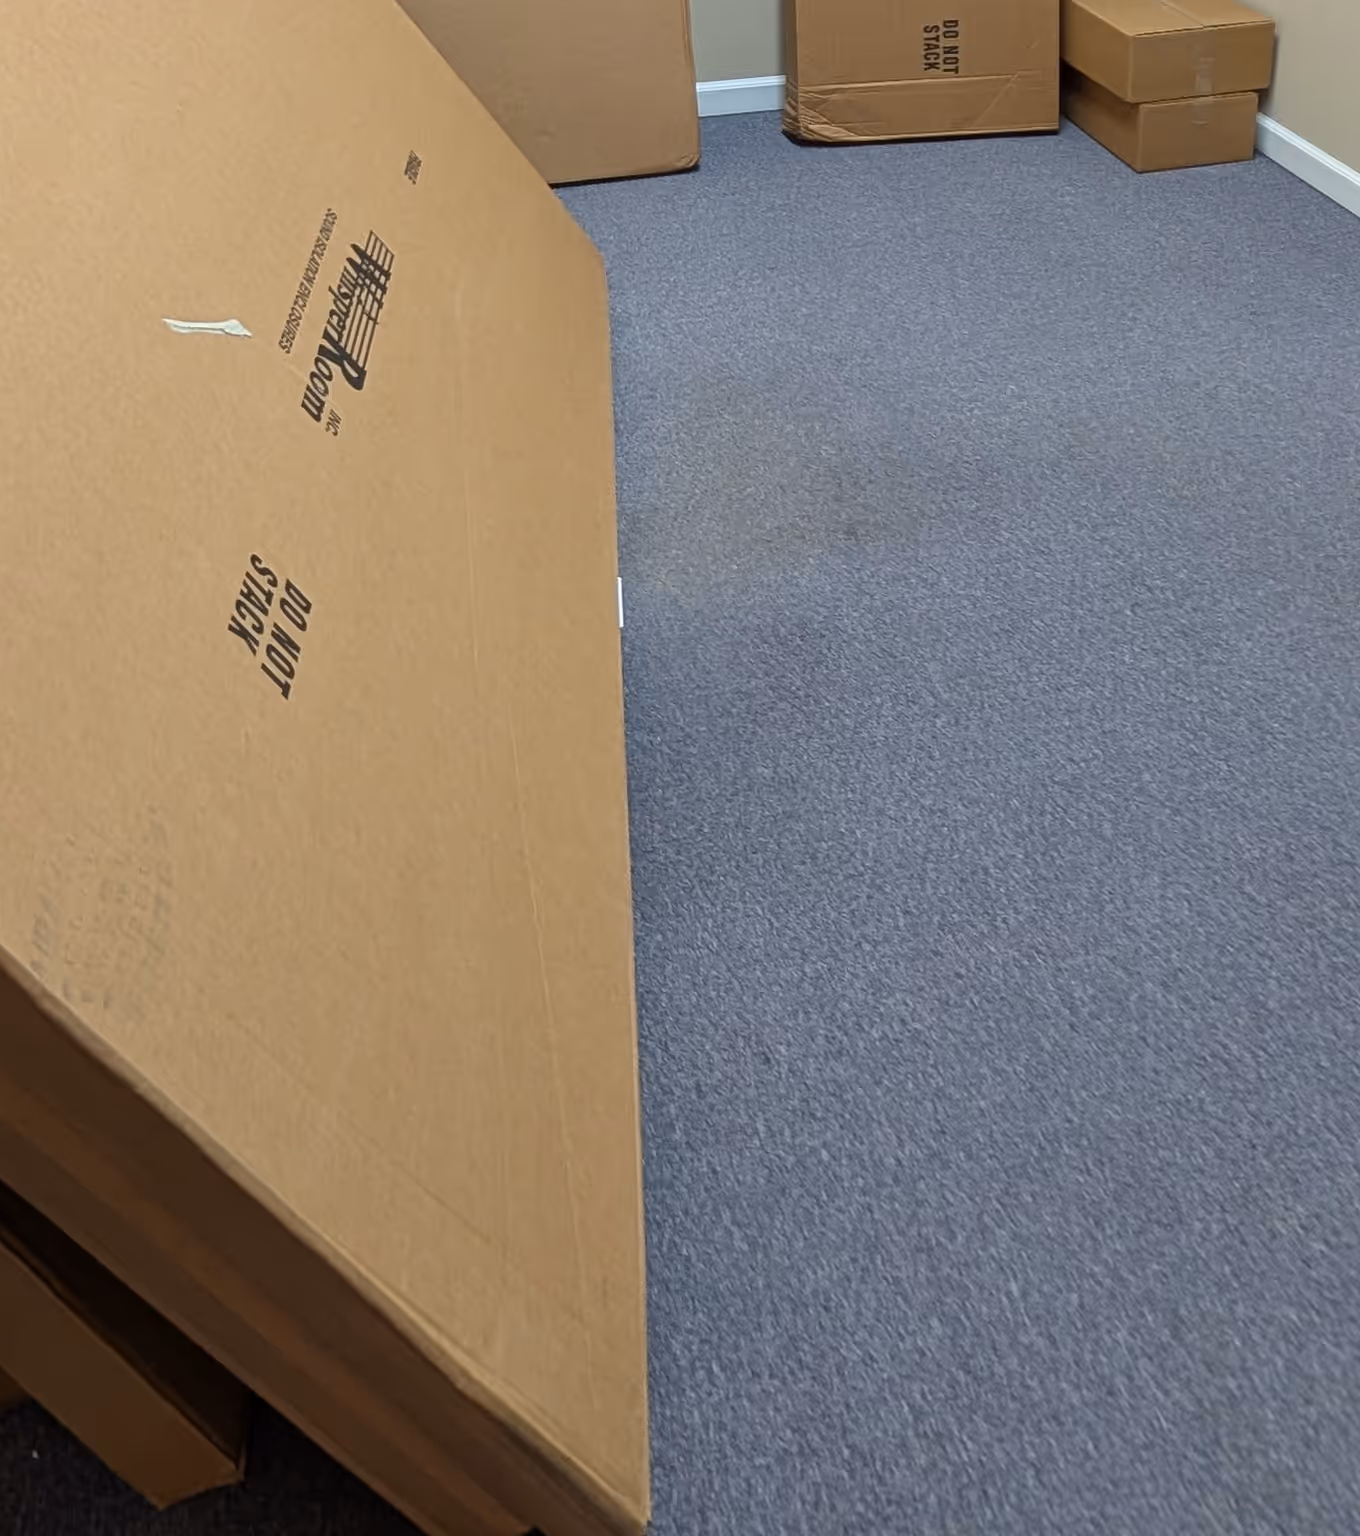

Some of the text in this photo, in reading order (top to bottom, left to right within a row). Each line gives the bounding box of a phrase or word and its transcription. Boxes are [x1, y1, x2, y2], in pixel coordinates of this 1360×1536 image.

[923, 26, 940, 71] STACK
[943, 20, 959, 74] DO NOT
[278, 208, 339, 354] SOUND ISOLATION ENCLOSURES
[325, 409, 342, 437] INC.
[227, 554, 278, 657] STACK
[261, 578, 313, 701] DO NOT
